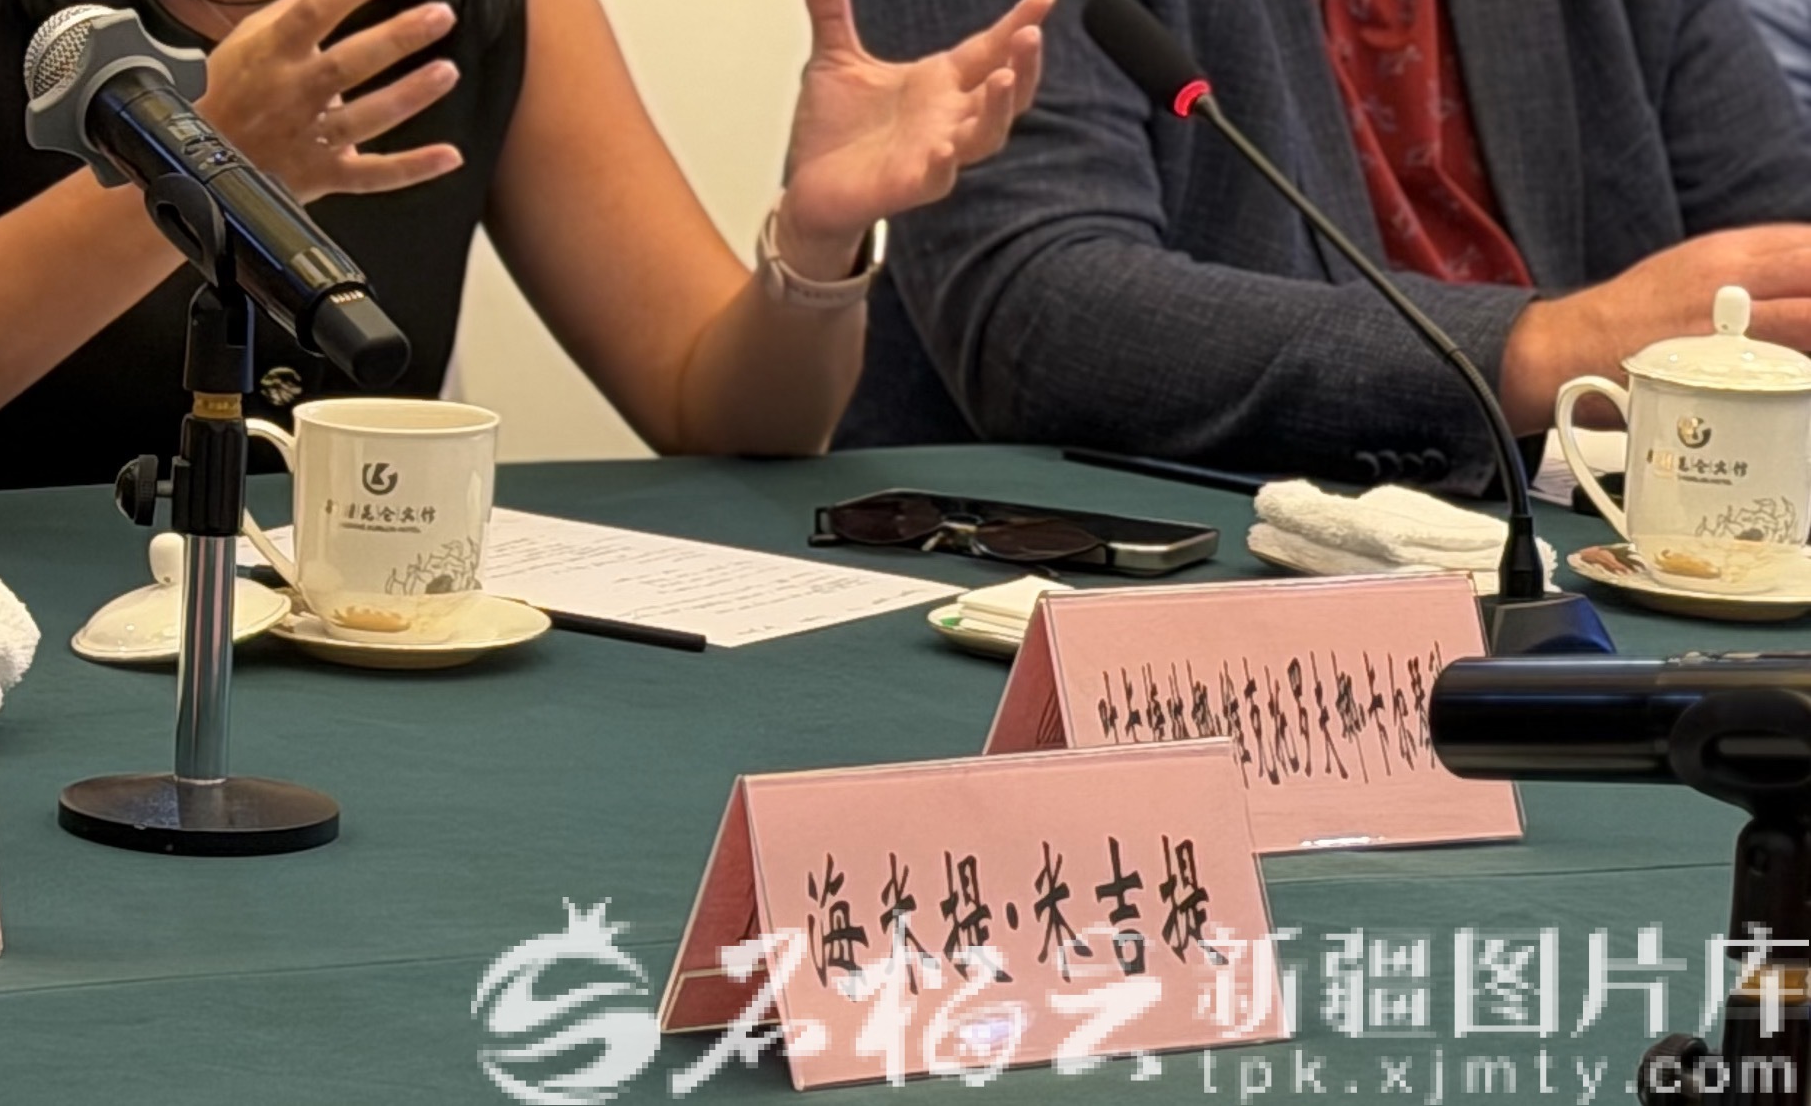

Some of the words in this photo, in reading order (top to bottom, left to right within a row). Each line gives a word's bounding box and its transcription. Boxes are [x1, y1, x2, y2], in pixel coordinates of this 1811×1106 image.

[806, 834, 1229, 995] 海米提·米吉提
